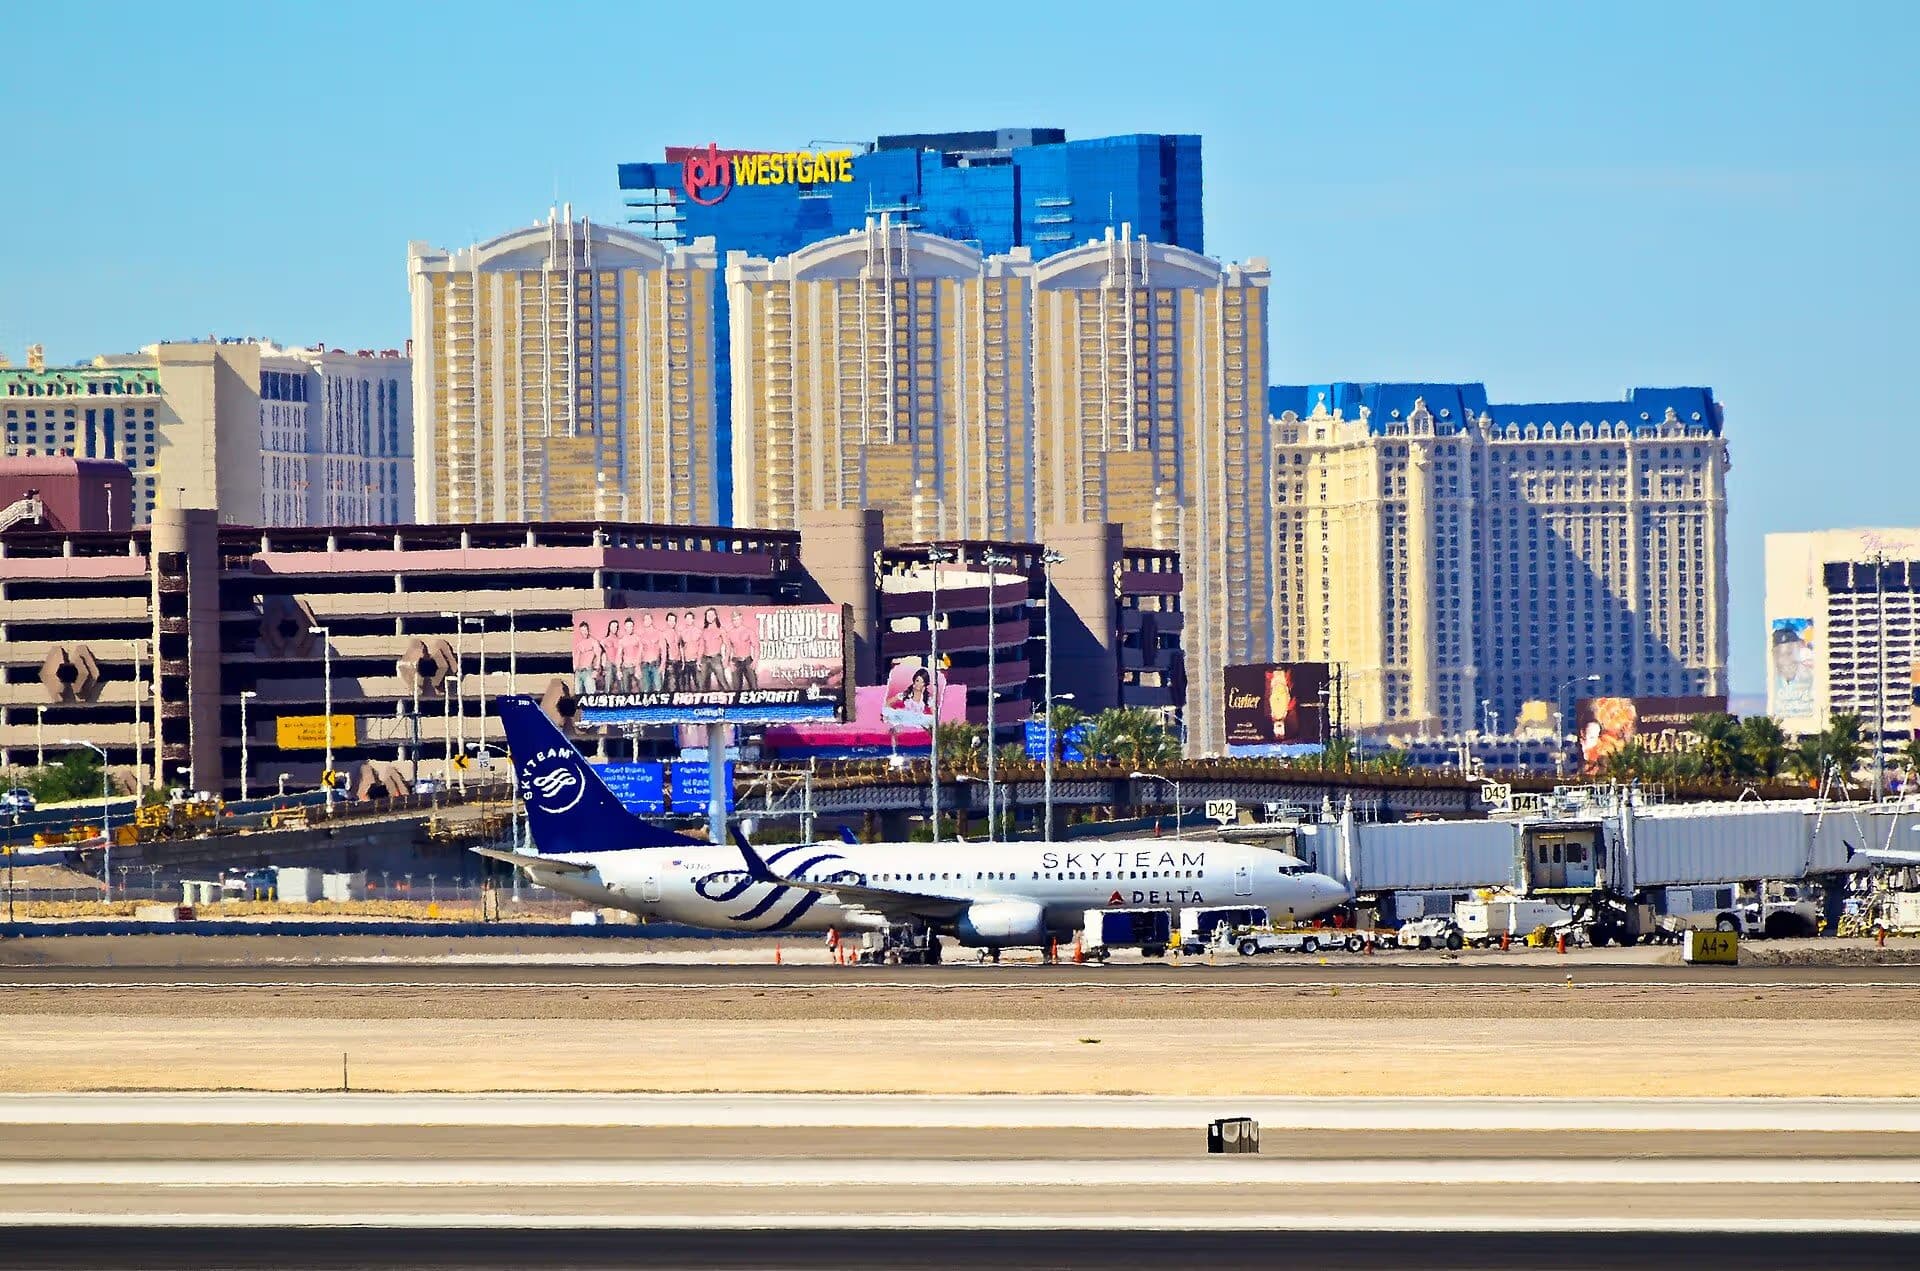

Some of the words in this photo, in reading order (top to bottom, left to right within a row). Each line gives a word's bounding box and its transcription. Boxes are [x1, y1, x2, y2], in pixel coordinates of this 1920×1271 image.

[733, 150, 855, 186] WESTGATE
[756, 613, 839, 640] THUNDER
[760, 640, 797, 660] DOWN
[800, 640, 840, 658] UNDER
[771, 663, 831, 684] Excalibur
[577, 694, 670, 707] AUSTRALIA'S
[673, 692, 736, 705] HOTTEST
[1228, 687, 1261, 709] Cartier
[521, 748, 571, 801] SKYTEAM
[1484, 786, 1507, 800] D43
[1512, 795, 1538, 811] D41
[1209, 802, 1232, 817] D42
[1043, 851, 1205, 869] SKYTEAM
[1132, 890, 1204, 904] DELTA
[1700, 936, 1718, 956] A4
